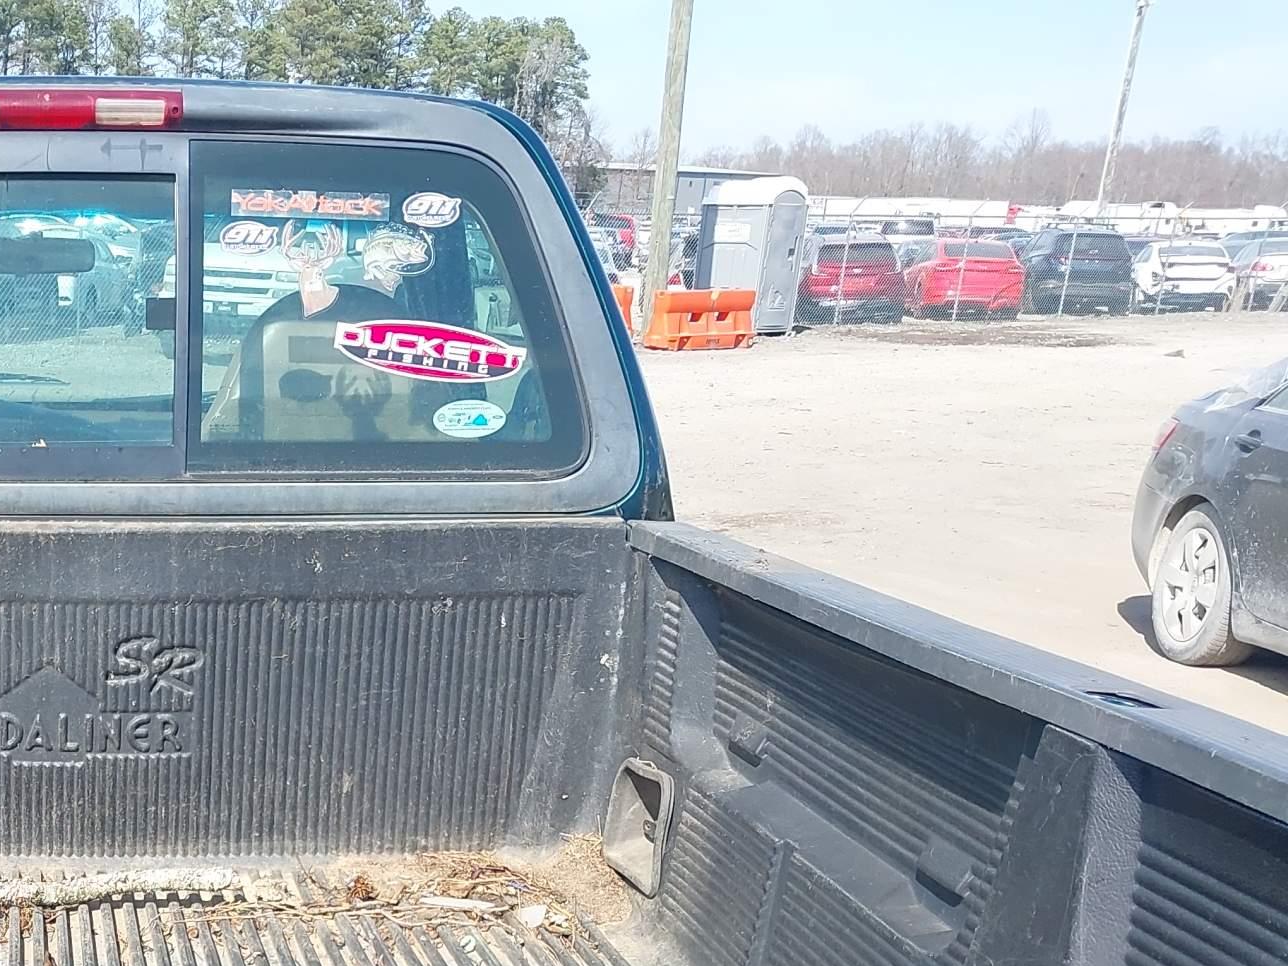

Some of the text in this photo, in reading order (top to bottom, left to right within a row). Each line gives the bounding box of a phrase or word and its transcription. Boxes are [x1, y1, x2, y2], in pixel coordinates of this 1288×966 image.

[405, 197, 459, 216] 911
[223, 227, 275, 245] 911
[337, 324, 527, 369] DUCKETT
[367, 349, 489, 374] FISHING
